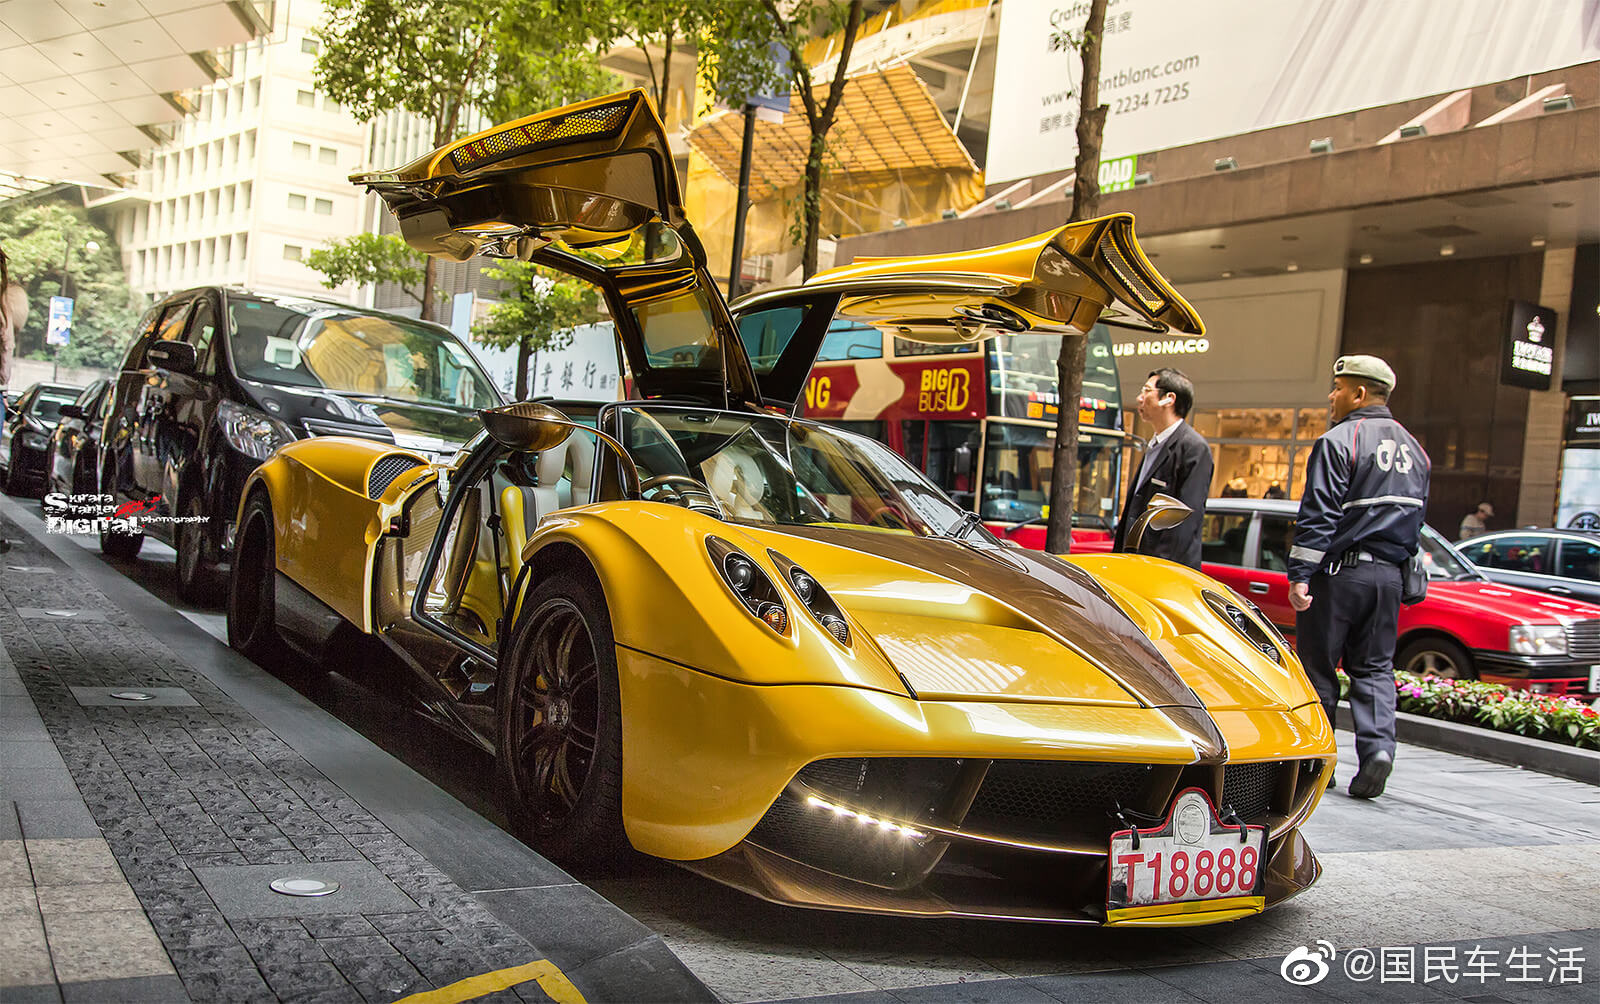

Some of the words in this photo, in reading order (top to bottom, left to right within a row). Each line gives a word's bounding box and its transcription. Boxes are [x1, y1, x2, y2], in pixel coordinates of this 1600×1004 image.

[1049, 1, 1092, 26] Crafte
[1115, 92, 1149, 115] 2234
[1154, 82, 1190, 105] 7225
[1092, 342, 1135, 357] CLUB
[1137, 338, 1210, 355] MONACO
[921, 368, 948, 392] BIG
[919, 391, 947, 412] BUS
[1117, 846, 1258, 903] T18888
